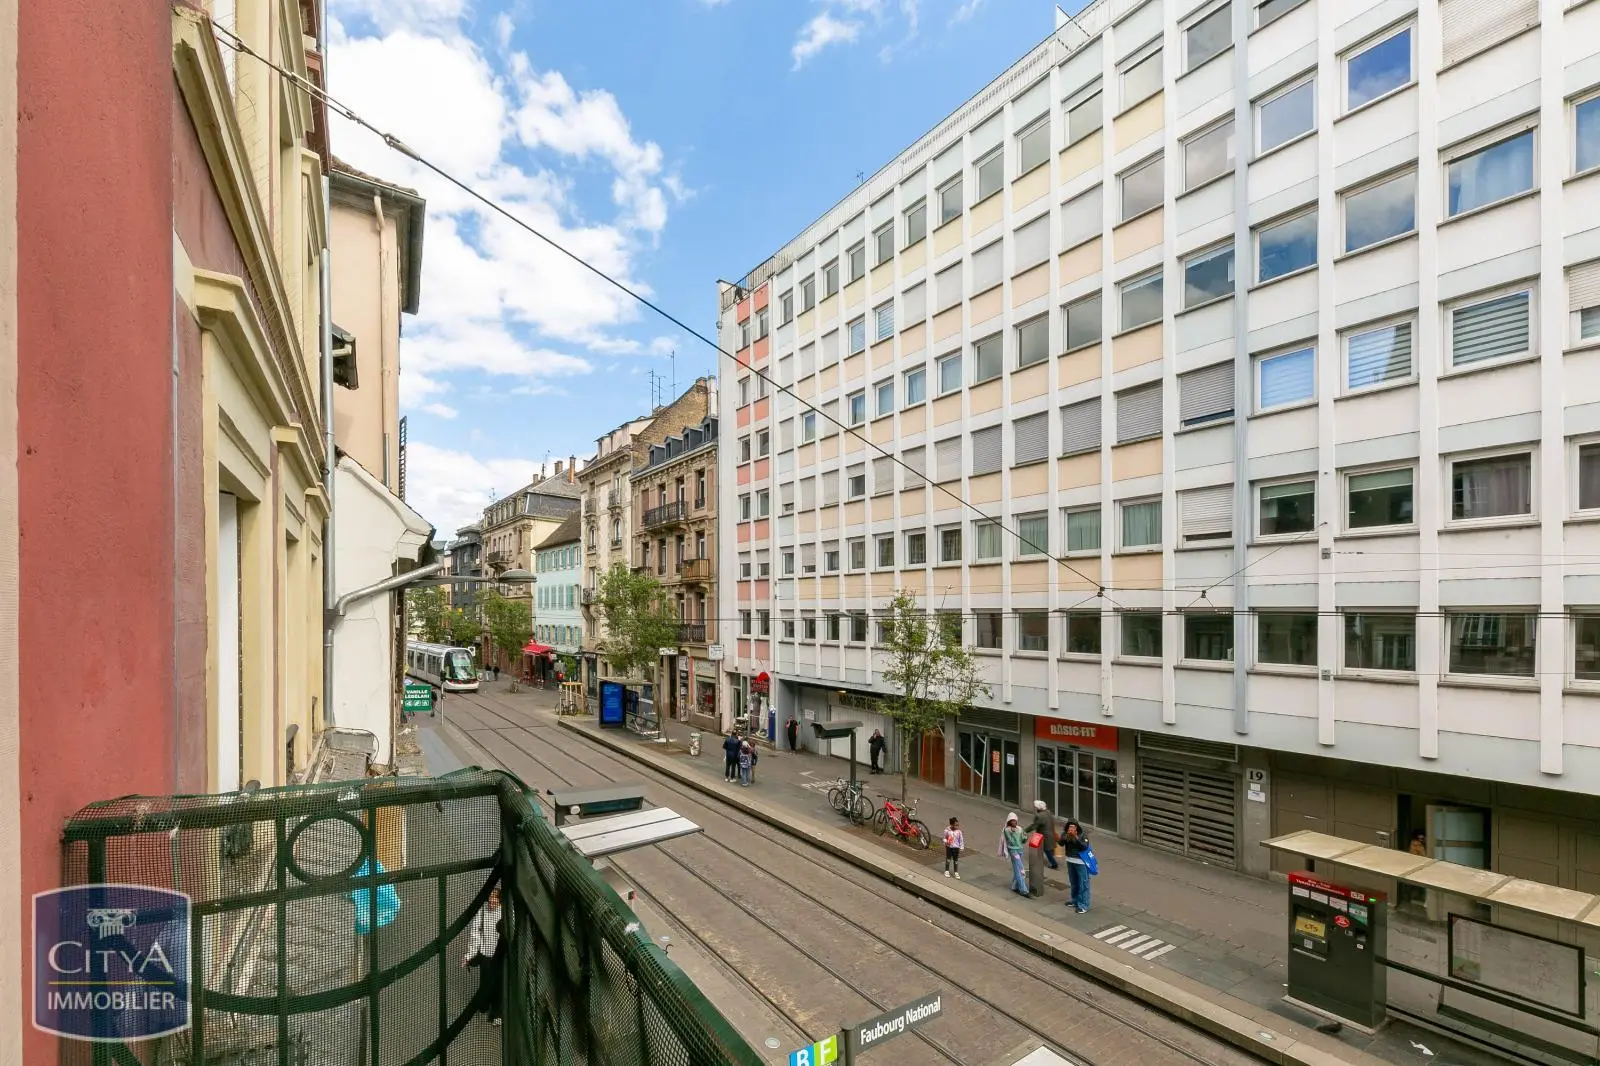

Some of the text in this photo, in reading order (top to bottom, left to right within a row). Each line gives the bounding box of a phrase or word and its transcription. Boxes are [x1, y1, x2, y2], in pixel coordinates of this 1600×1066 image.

[1248, 770, 1264, 781] 19
[860, 996, 941, 1046] Faubourg National
[796, 1038, 832, 1066] B F
